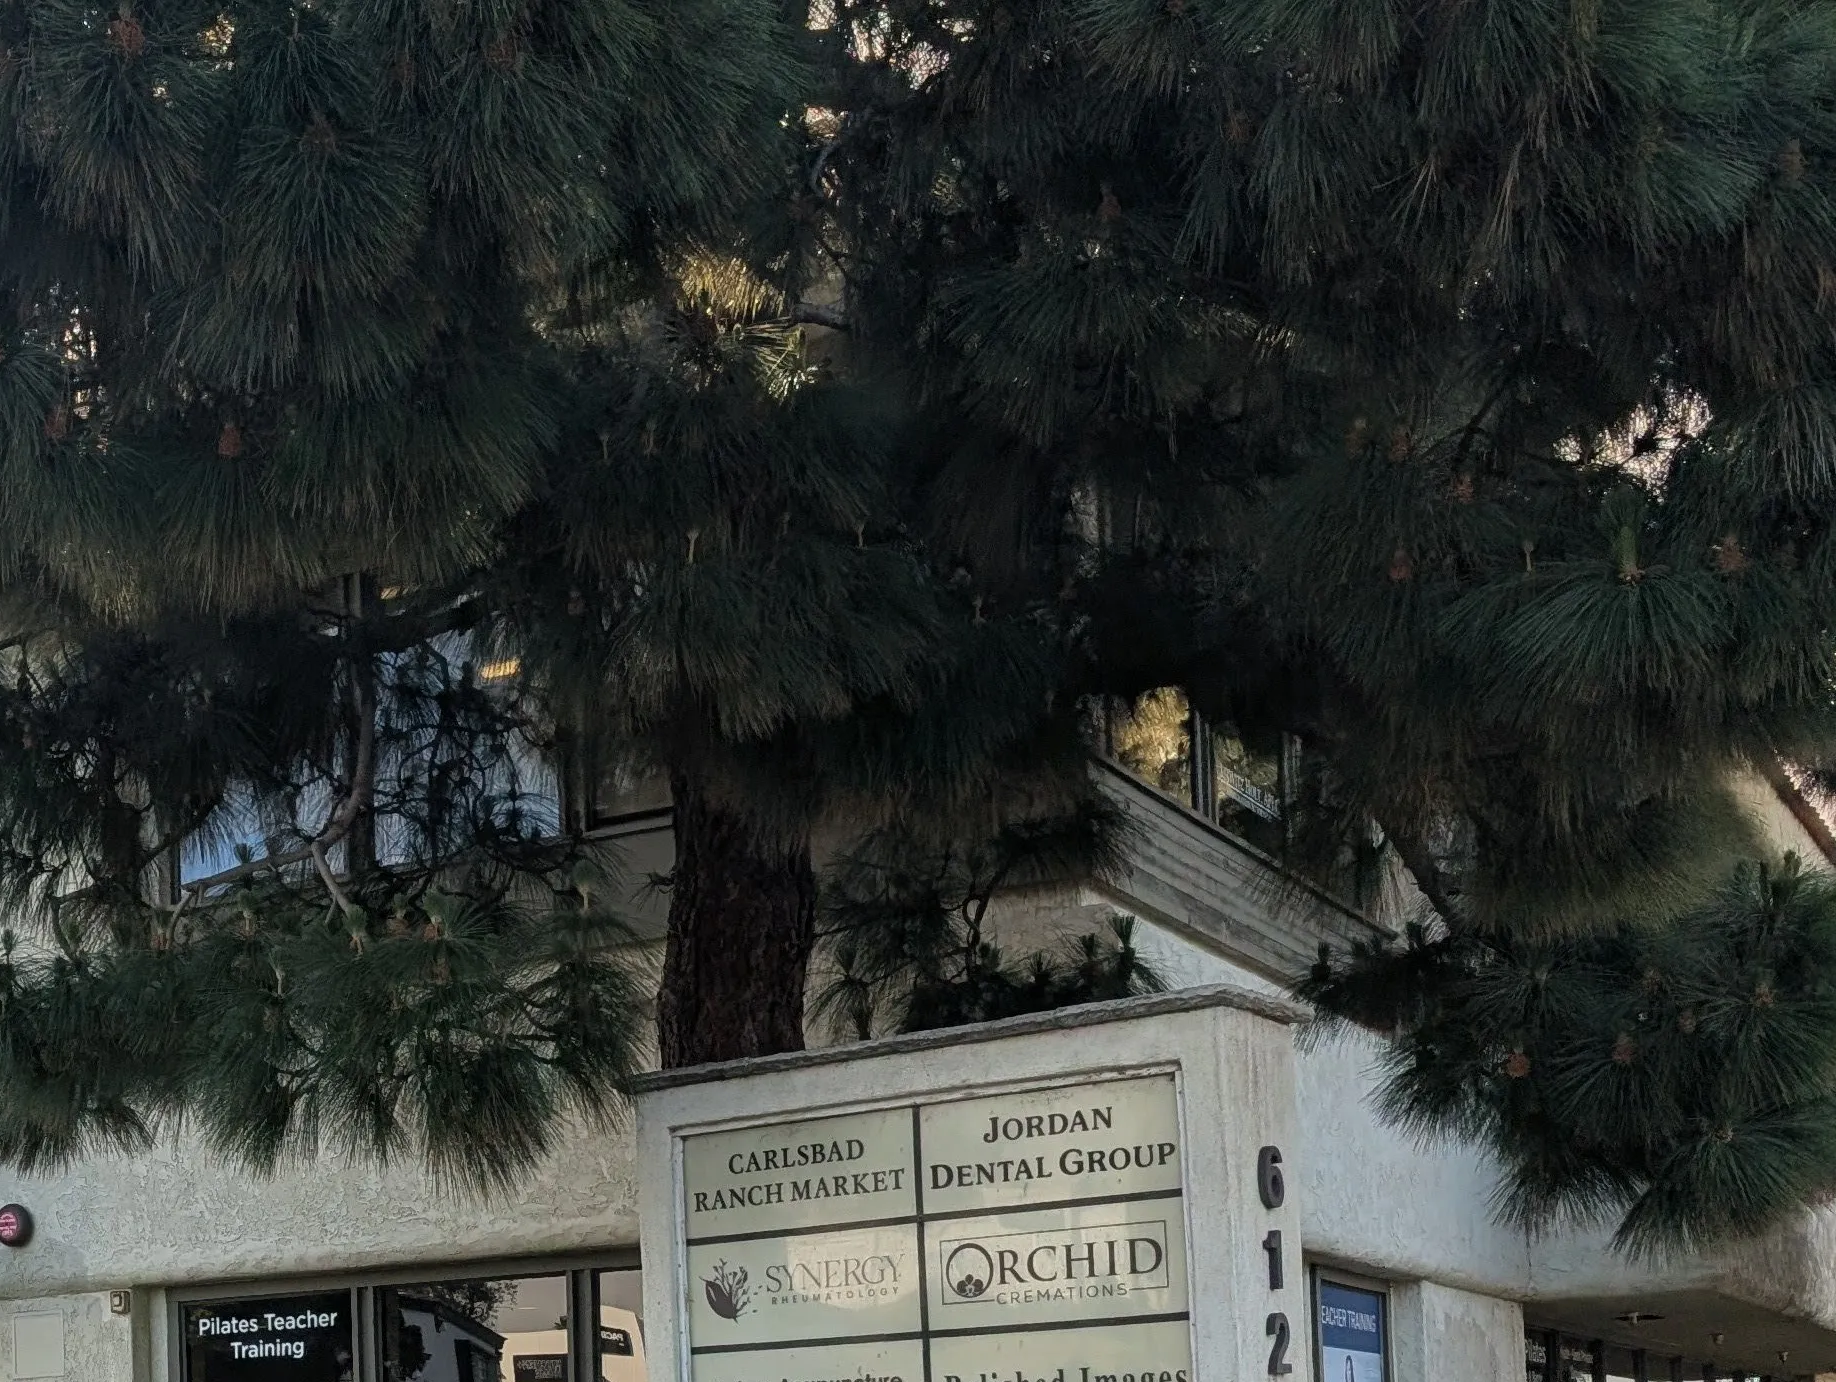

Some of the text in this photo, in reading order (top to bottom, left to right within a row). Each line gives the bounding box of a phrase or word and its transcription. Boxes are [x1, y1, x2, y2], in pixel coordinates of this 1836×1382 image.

[983, 1107, 1113, 1144] JORDAN
[728, 1138, 865, 1176] CARLSBAD
[930, 1142, 1176, 1190] DENTAL GROUP
[693, 1167, 906, 1213] RANCH MARKET
[765, 1253, 905, 1293] SYNERGY
[946, 1236, 1163, 1298] ORCHID
[771, 1286, 899, 1305] RHEUMATOLOGY
[996, 1282, 1127, 1305] CREMATIONS
[198, 1310, 338, 1336] Pilates Teacher
[1321, 1305, 1347, 1327] EACHER
[230, 1338, 305, 1360] Training
